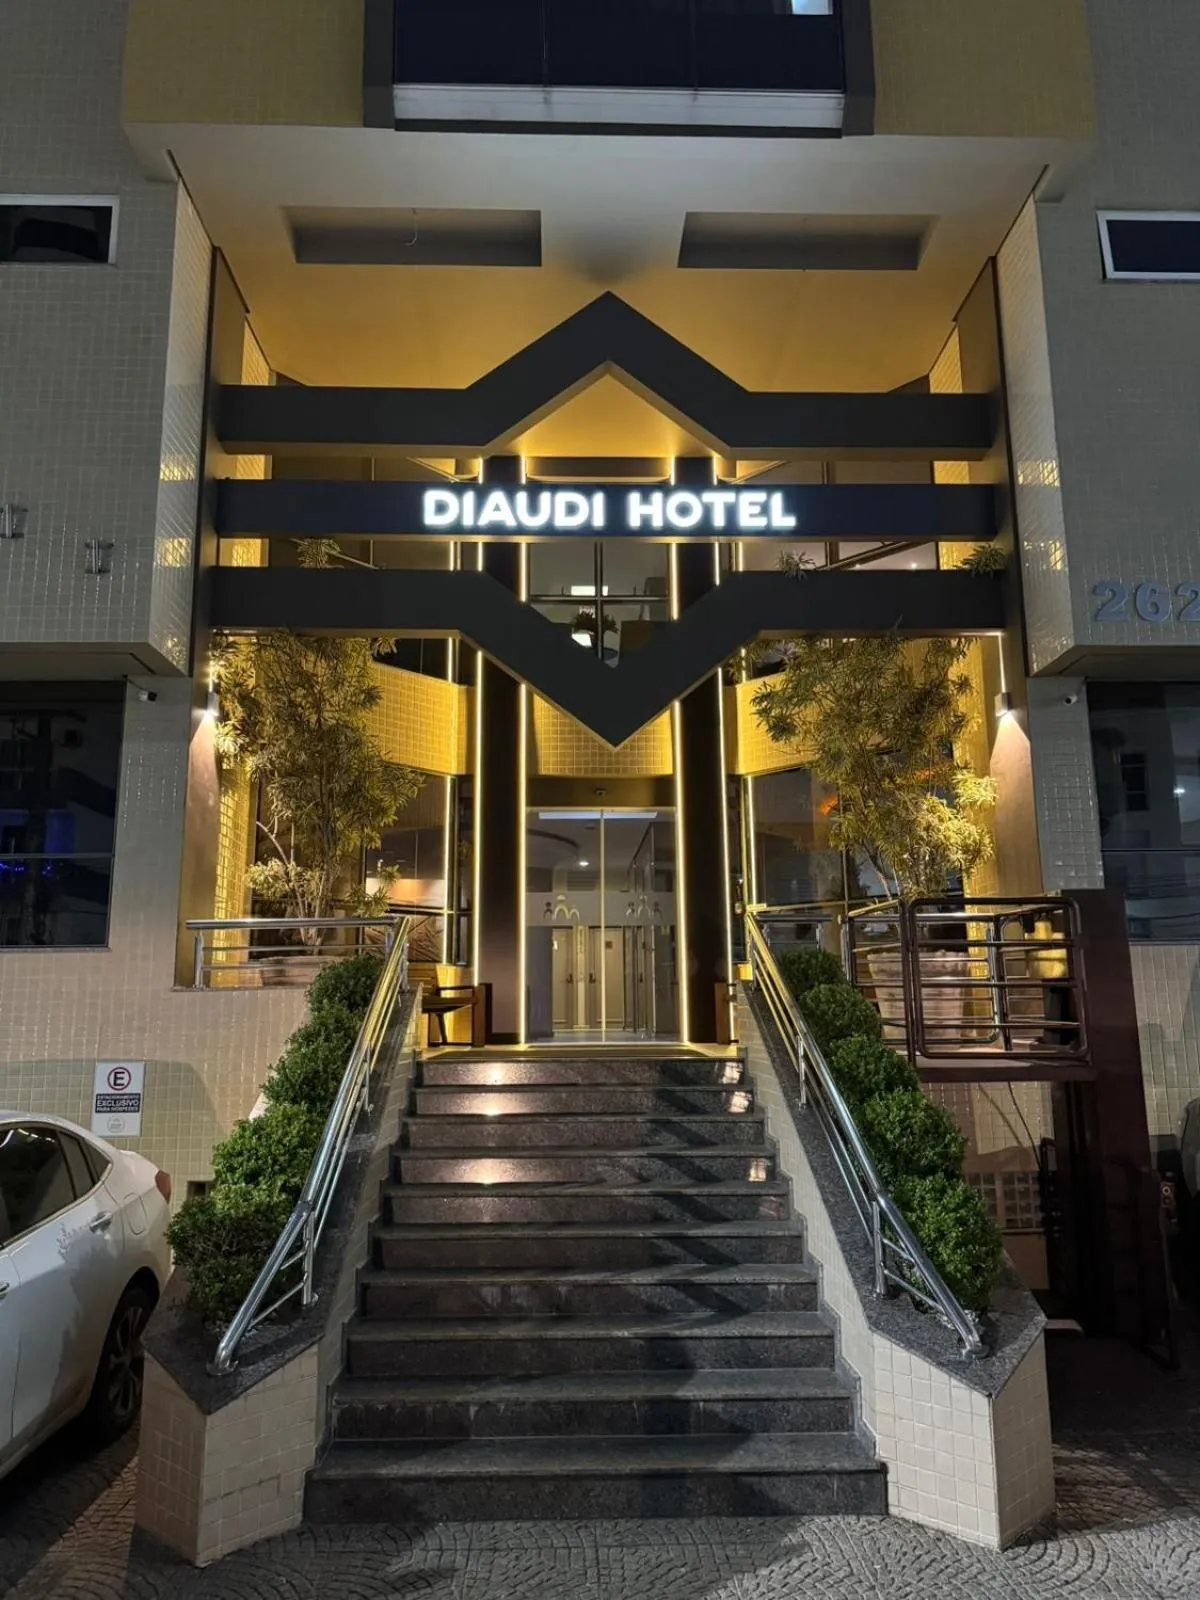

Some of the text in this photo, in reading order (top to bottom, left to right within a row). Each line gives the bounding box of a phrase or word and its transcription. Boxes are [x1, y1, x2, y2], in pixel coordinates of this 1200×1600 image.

[423, 490, 796, 529] DIAUDI HOTEL
[1092, 580, 1200, 622] 262
[114, 1072, 125, 1086] E
[97, 1099, 139, 1107] EXCLUSIVO
